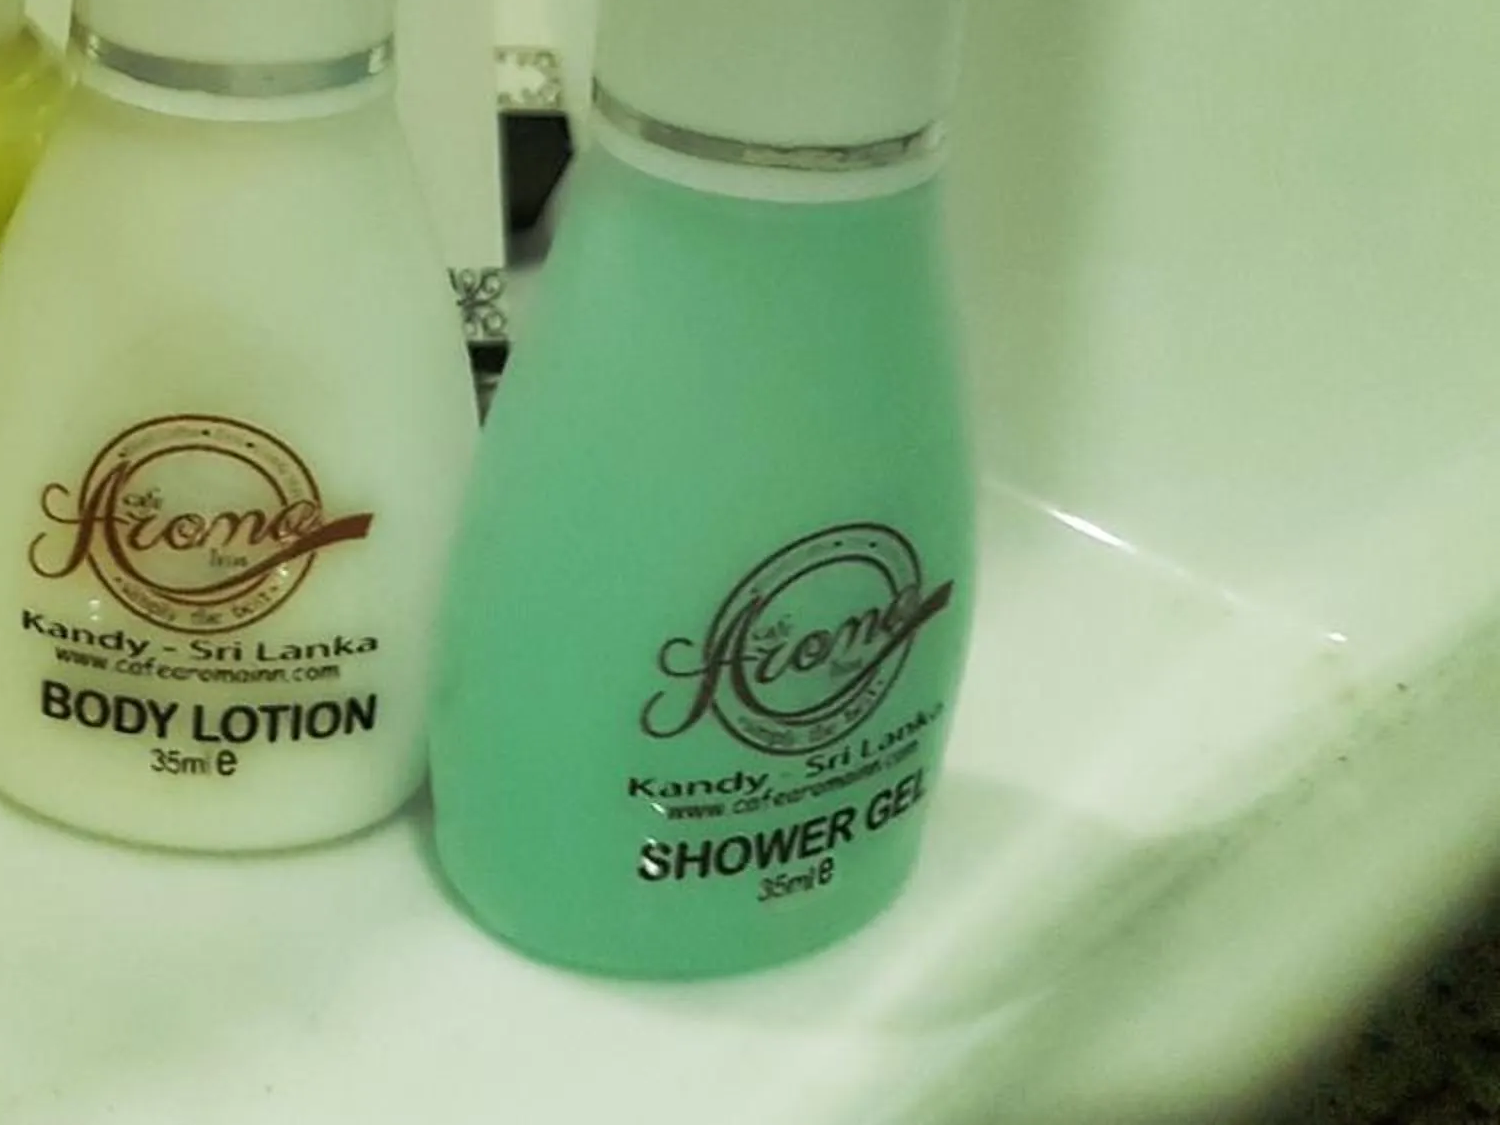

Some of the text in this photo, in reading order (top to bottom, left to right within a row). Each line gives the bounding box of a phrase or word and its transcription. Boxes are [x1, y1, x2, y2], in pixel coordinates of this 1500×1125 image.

[22, 610, 150, 657] Kandy
[190, 639, 242, 662] Sri
[256, 635, 379, 662] Lanka
[42, 680, 378, 744] BODY LOTION
[628, 771, 769, 797] Kandy
[806, 746, 849, 778] Sri
[638, 769, 927, 881] SHOWER GEL
